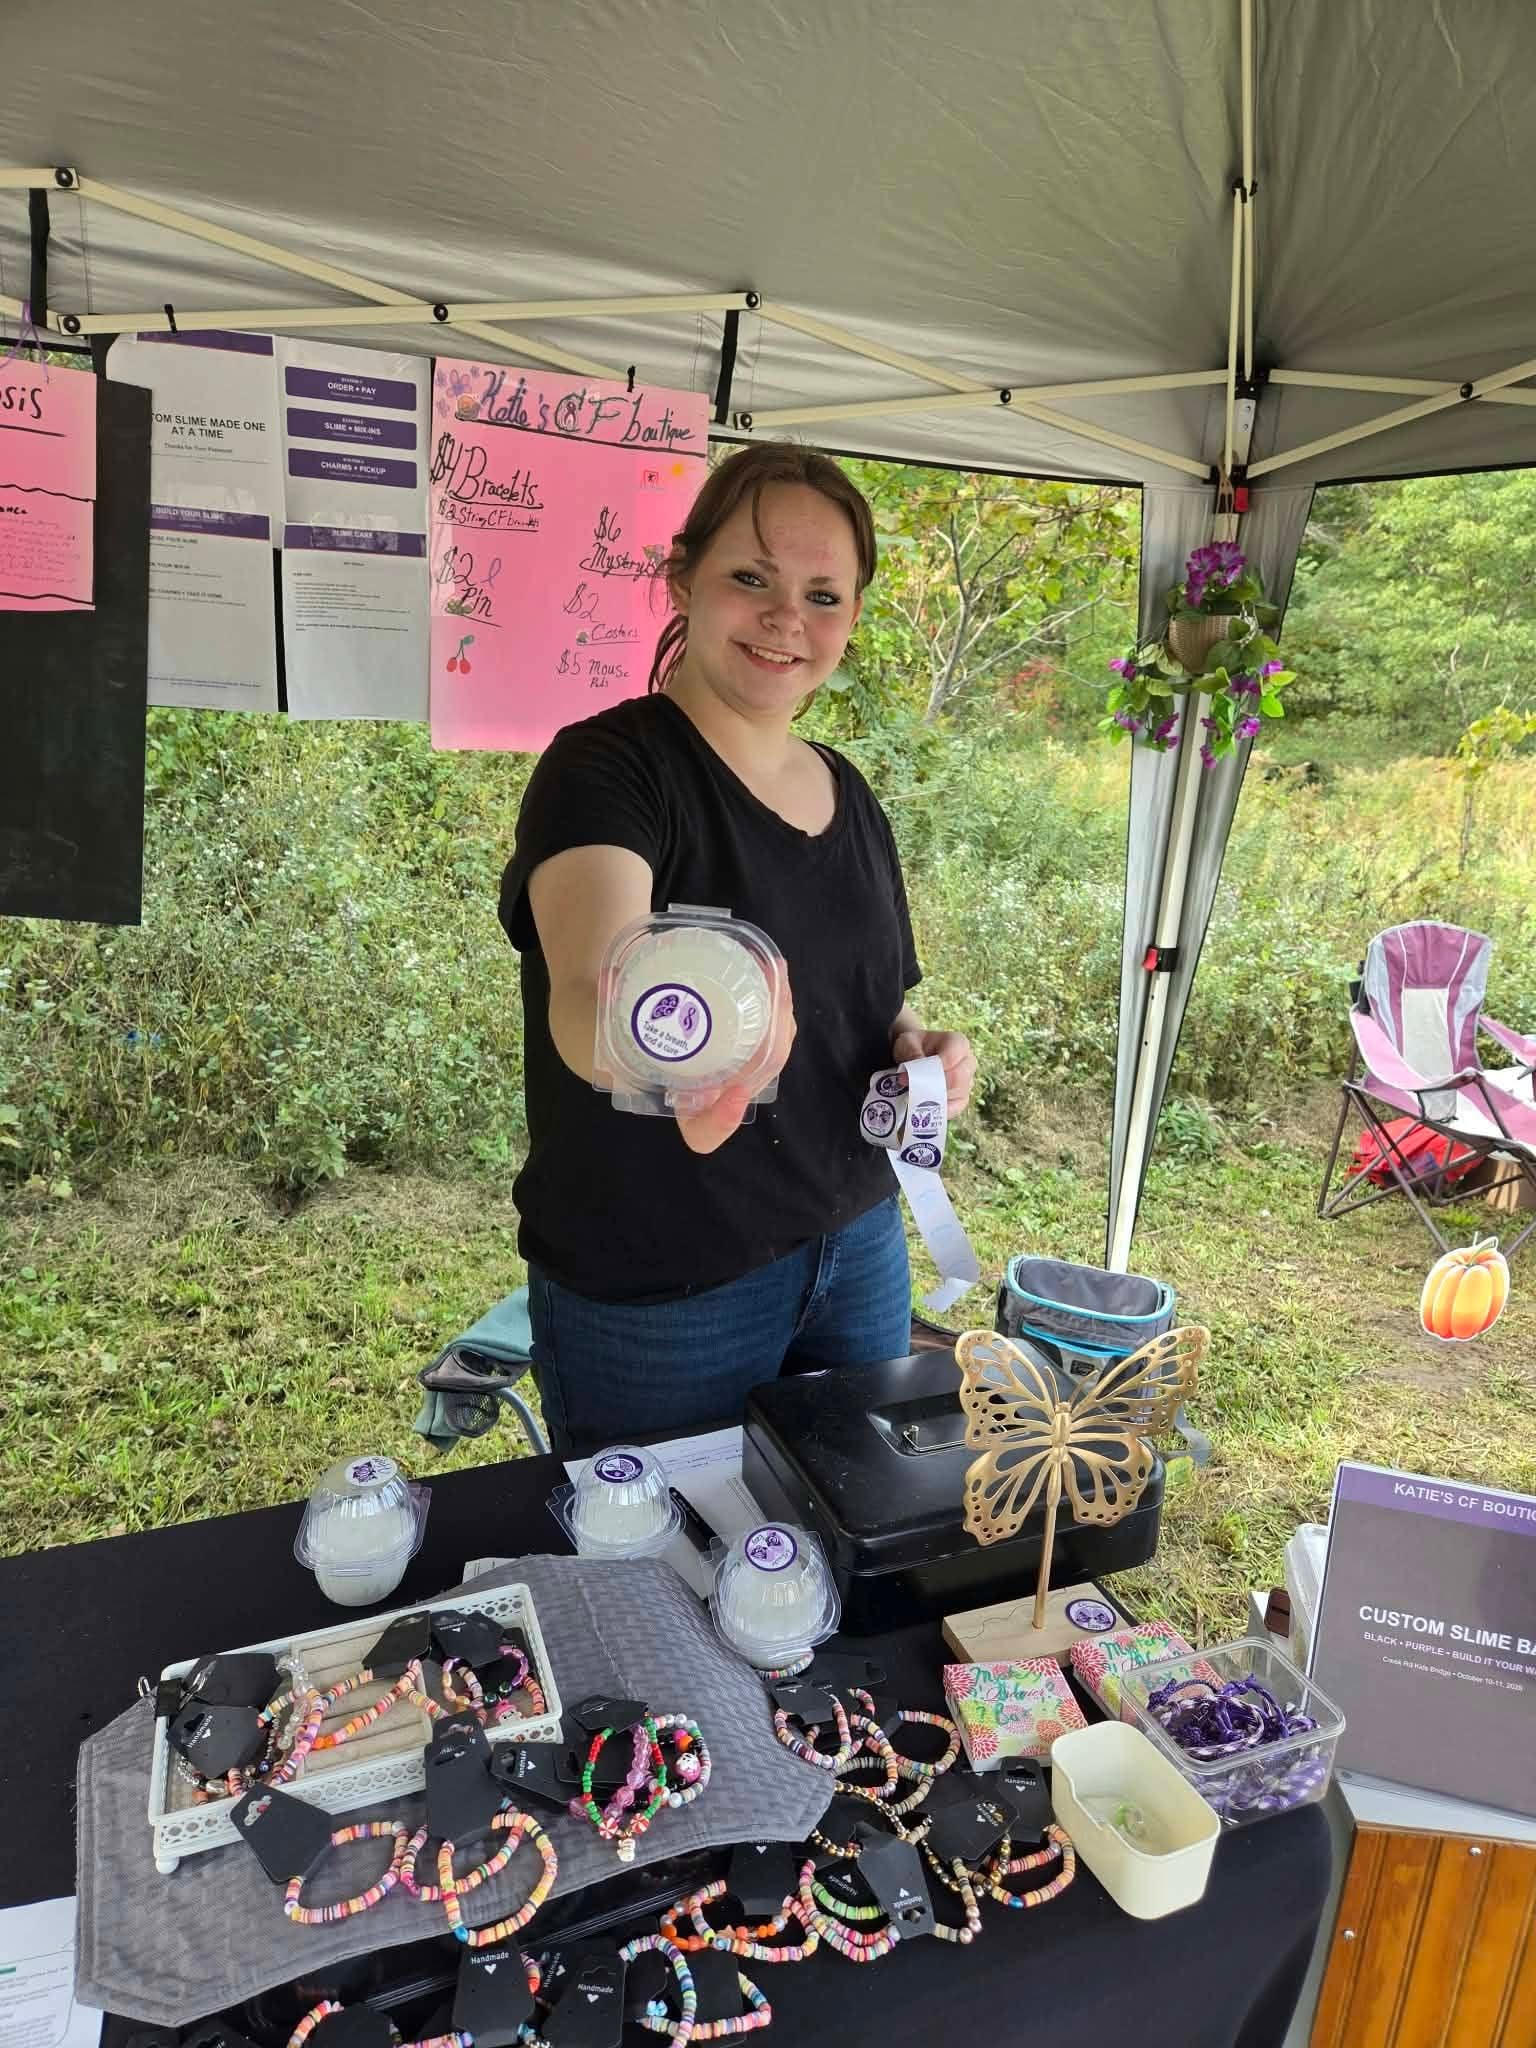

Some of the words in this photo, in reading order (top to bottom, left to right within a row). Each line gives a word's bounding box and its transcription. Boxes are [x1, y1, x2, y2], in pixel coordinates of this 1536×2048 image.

[327, 382, 354, 392] ORDER
[361, 386, 377, 395] PAY
[175, 415, 207, 427] SLIME
[209, 417, 241, 430] MADE
[243, 421, 267, 432] ONE
[171, 426, 186, 436] AT
[188, 427, 196, 437] A
[199, 428, 224, 439] TIME
[320, 461, 353, 472] CHARMS
[359, 465, 387, 475] PICKUP
[593, 506, 622, 542] $6
[436, 545, 474, 587] $2
[1393, 1482, 1455, 1504] KATIE'S
[1457, 1495, 1481, 1509] CF
[1359, 1605, 1445, 1636] CUSTOM
[1450, 1624, 1512, 1651] SLIME
[1363, 1631, 1398, 1646] BLACK
[1405, 1640, 1445, 1656] PURPLE
[1452, 1650, 1482, 1664] BUILD
[1484, 1656, 1494, 1665] IT
[1495, 1658, 1523, 1673] YOUR
[1456, 1671, 1484, 1683] October
[471, 1951, 510, 1965] Handmade
[577, 1983, 615, 1994] Handmade
